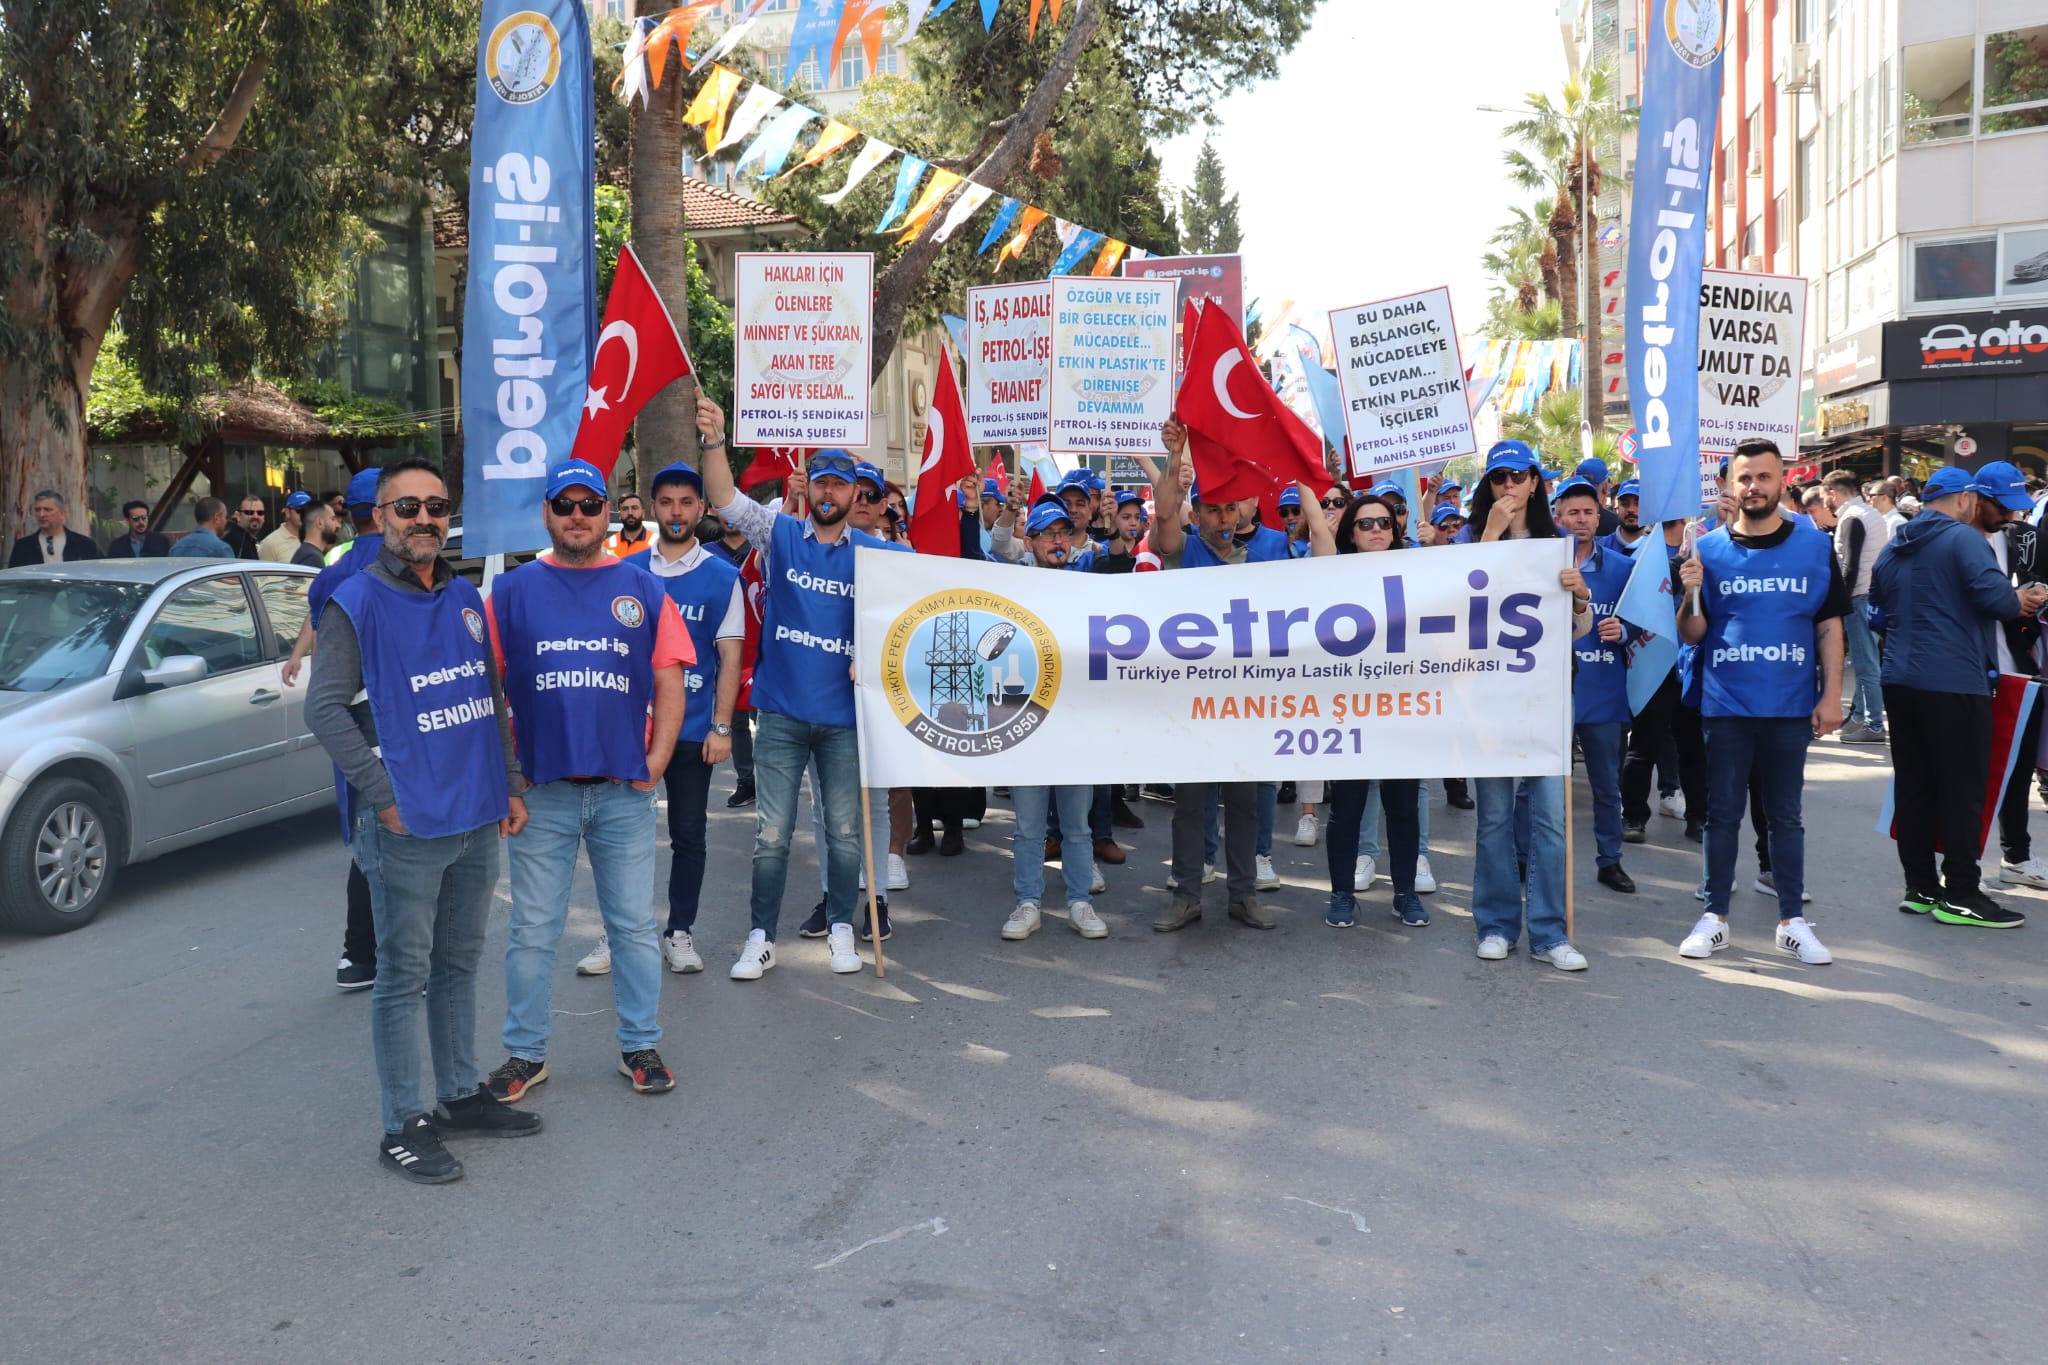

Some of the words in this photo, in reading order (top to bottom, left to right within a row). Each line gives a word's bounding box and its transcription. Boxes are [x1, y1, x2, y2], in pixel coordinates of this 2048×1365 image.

[764, 266, 815, 282] HAKLARI
[819, 261, 844, 286] İÇİN
[775, 291, 832, 312] ÖLENLERE
[1066, 287, 1112, 304] ÖZGÜR
[1116, 291, 1131, 304] VE
[1136, 289, 1160, 307] EŞİT
[1700, 283, 1793, 314] SENDİKA
[975, 294, 989, 328] İŞ,
[993, 297, 1008, 327] AŞ
[1059, 309, 1080, 325] BİR
[1083, 312, 1136, 326] GELECEK
[1141, 311, 1167, 330] İÇİN
[1357, 310, 1377, 326] BU
[1383, 300, 1427, 320] DAHA
[744, 320, 790, 341] MİNNET
[793, 325, 807, 341] VE
[811, 321, 863, 346] ŞÜKRAN,
[1073, 331, 1151, 349] MÜCADELE...
[1350, 319, 1441, 348] BAŞLANGIÇ,
[1603, 270, 1623, 393] fial
[1709, 317, 1778, 345] VARSA
[982, 331, 1050, 366] PETROL-İŞE
[1058, 353, 1095, 369] ETKİN
[1351, 338, 1447, 369] MÜCADELEYE
[771, 354, 805, 370] AKAN
[809, 354, 835, 370] TERE
[1761, 354, 1792, 378] DA
[1083, 375, 1140, 394] DİRENİŞE
[1368, 366, 1436, 387] DEVAM...
[751, 383, 785, 400] SAYGI
[788, 383, 804, 400] VE
[806, 384, 854, 400] SELAM...
[991, 378, 1042, 404] EMANET
[1351, 391, 1396, 412] ETKİN
[1400, 378, 1461, 403] PLASTİK
[1717, 382, 1761, 408] VAR
[741, 407, 799, 422] PETROL-İŞ
[802, 407, 863, 420] SENDİKASI
[971, 411, 1014, 424] PETROL-İŞ
[1077, 400, 1144, 415] DEVAMMM
[1380, 402, 1439, 430] İŞÇİLERİ
[757, 425, 803, 438] MANİSA
[807, 425, 847, 440] ŞUBESİ
[983, 426, 1018, 438] MANİSA
[1053, 418, 1107, 432] PETROL-İŞ
[1356, 432, 1409, 451] PETROL-İŞ
[1412, 422, 1468, 442] SENDİKASI
[1737, 420, 1794, 434] SENDİKASI
[1068, 436, 1111, 447] MANİSA
[1115, 436, 1151, 448] ŞUBESİ
[1373, 449, 1417, 465] MANİSA
[1419, 441, 1456, 459] ŞUBESİ
[1719, 575, 1808, 596] GÖREVLİ
[919, 596, 955, 617] KİMYA
[959, 595, 1002, 611] LASTİK
[1003, 605, 1047, 638] İŞÇİLERİ
[1088, 569, 1544, 681] petrol-iş
[536, 637, 630, 657] petrol-iş
[889, 613, 920, 657] PETROL
[1712, 643, 1806, 668] petrol-iş
[536, 667, 630, 694] SENDİKASI
[1039, 638, 1057, 701] SENDİKASI
[1116, 665, 1181, 683] Türkiye
[1186, 665, 1237, 680] Petrol
[1243, 664, 1296, 682] Kimya
[1302, 662, 1353, 678] Lastik
[1358, 658, 1414, 680] İşçileri
[1419, 658, 1500, 675] Sendikası
[887, 660, 910, 714] TÜRKİYE
[914, 720, 1003, 753] PETROL-İŞ
[1005, 711, 1039, 742] 1950
[1273, 728, 1361, 756] 2021
